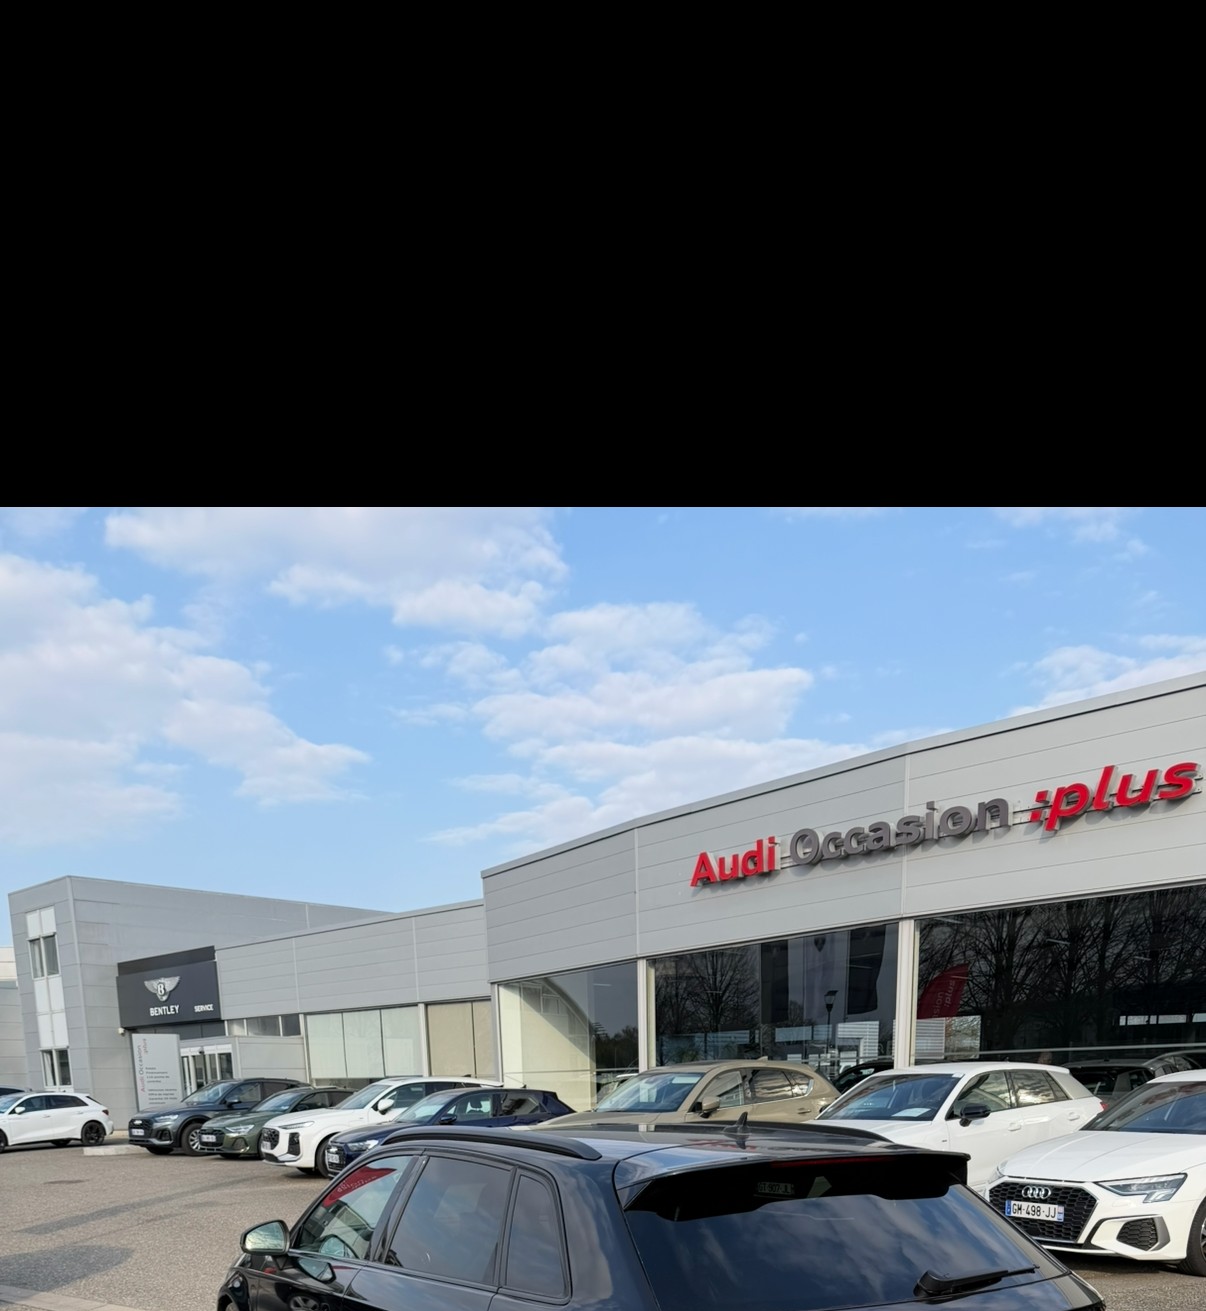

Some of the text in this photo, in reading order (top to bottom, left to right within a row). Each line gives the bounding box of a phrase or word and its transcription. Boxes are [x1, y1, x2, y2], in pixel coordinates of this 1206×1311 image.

[690, 835, 778, 888] Audi
[790, 798, 1010, 866] Occasion
[149, 1004, 180, 1017] BENTLEY
[193, 1003, 214, 1013] SERVICE
